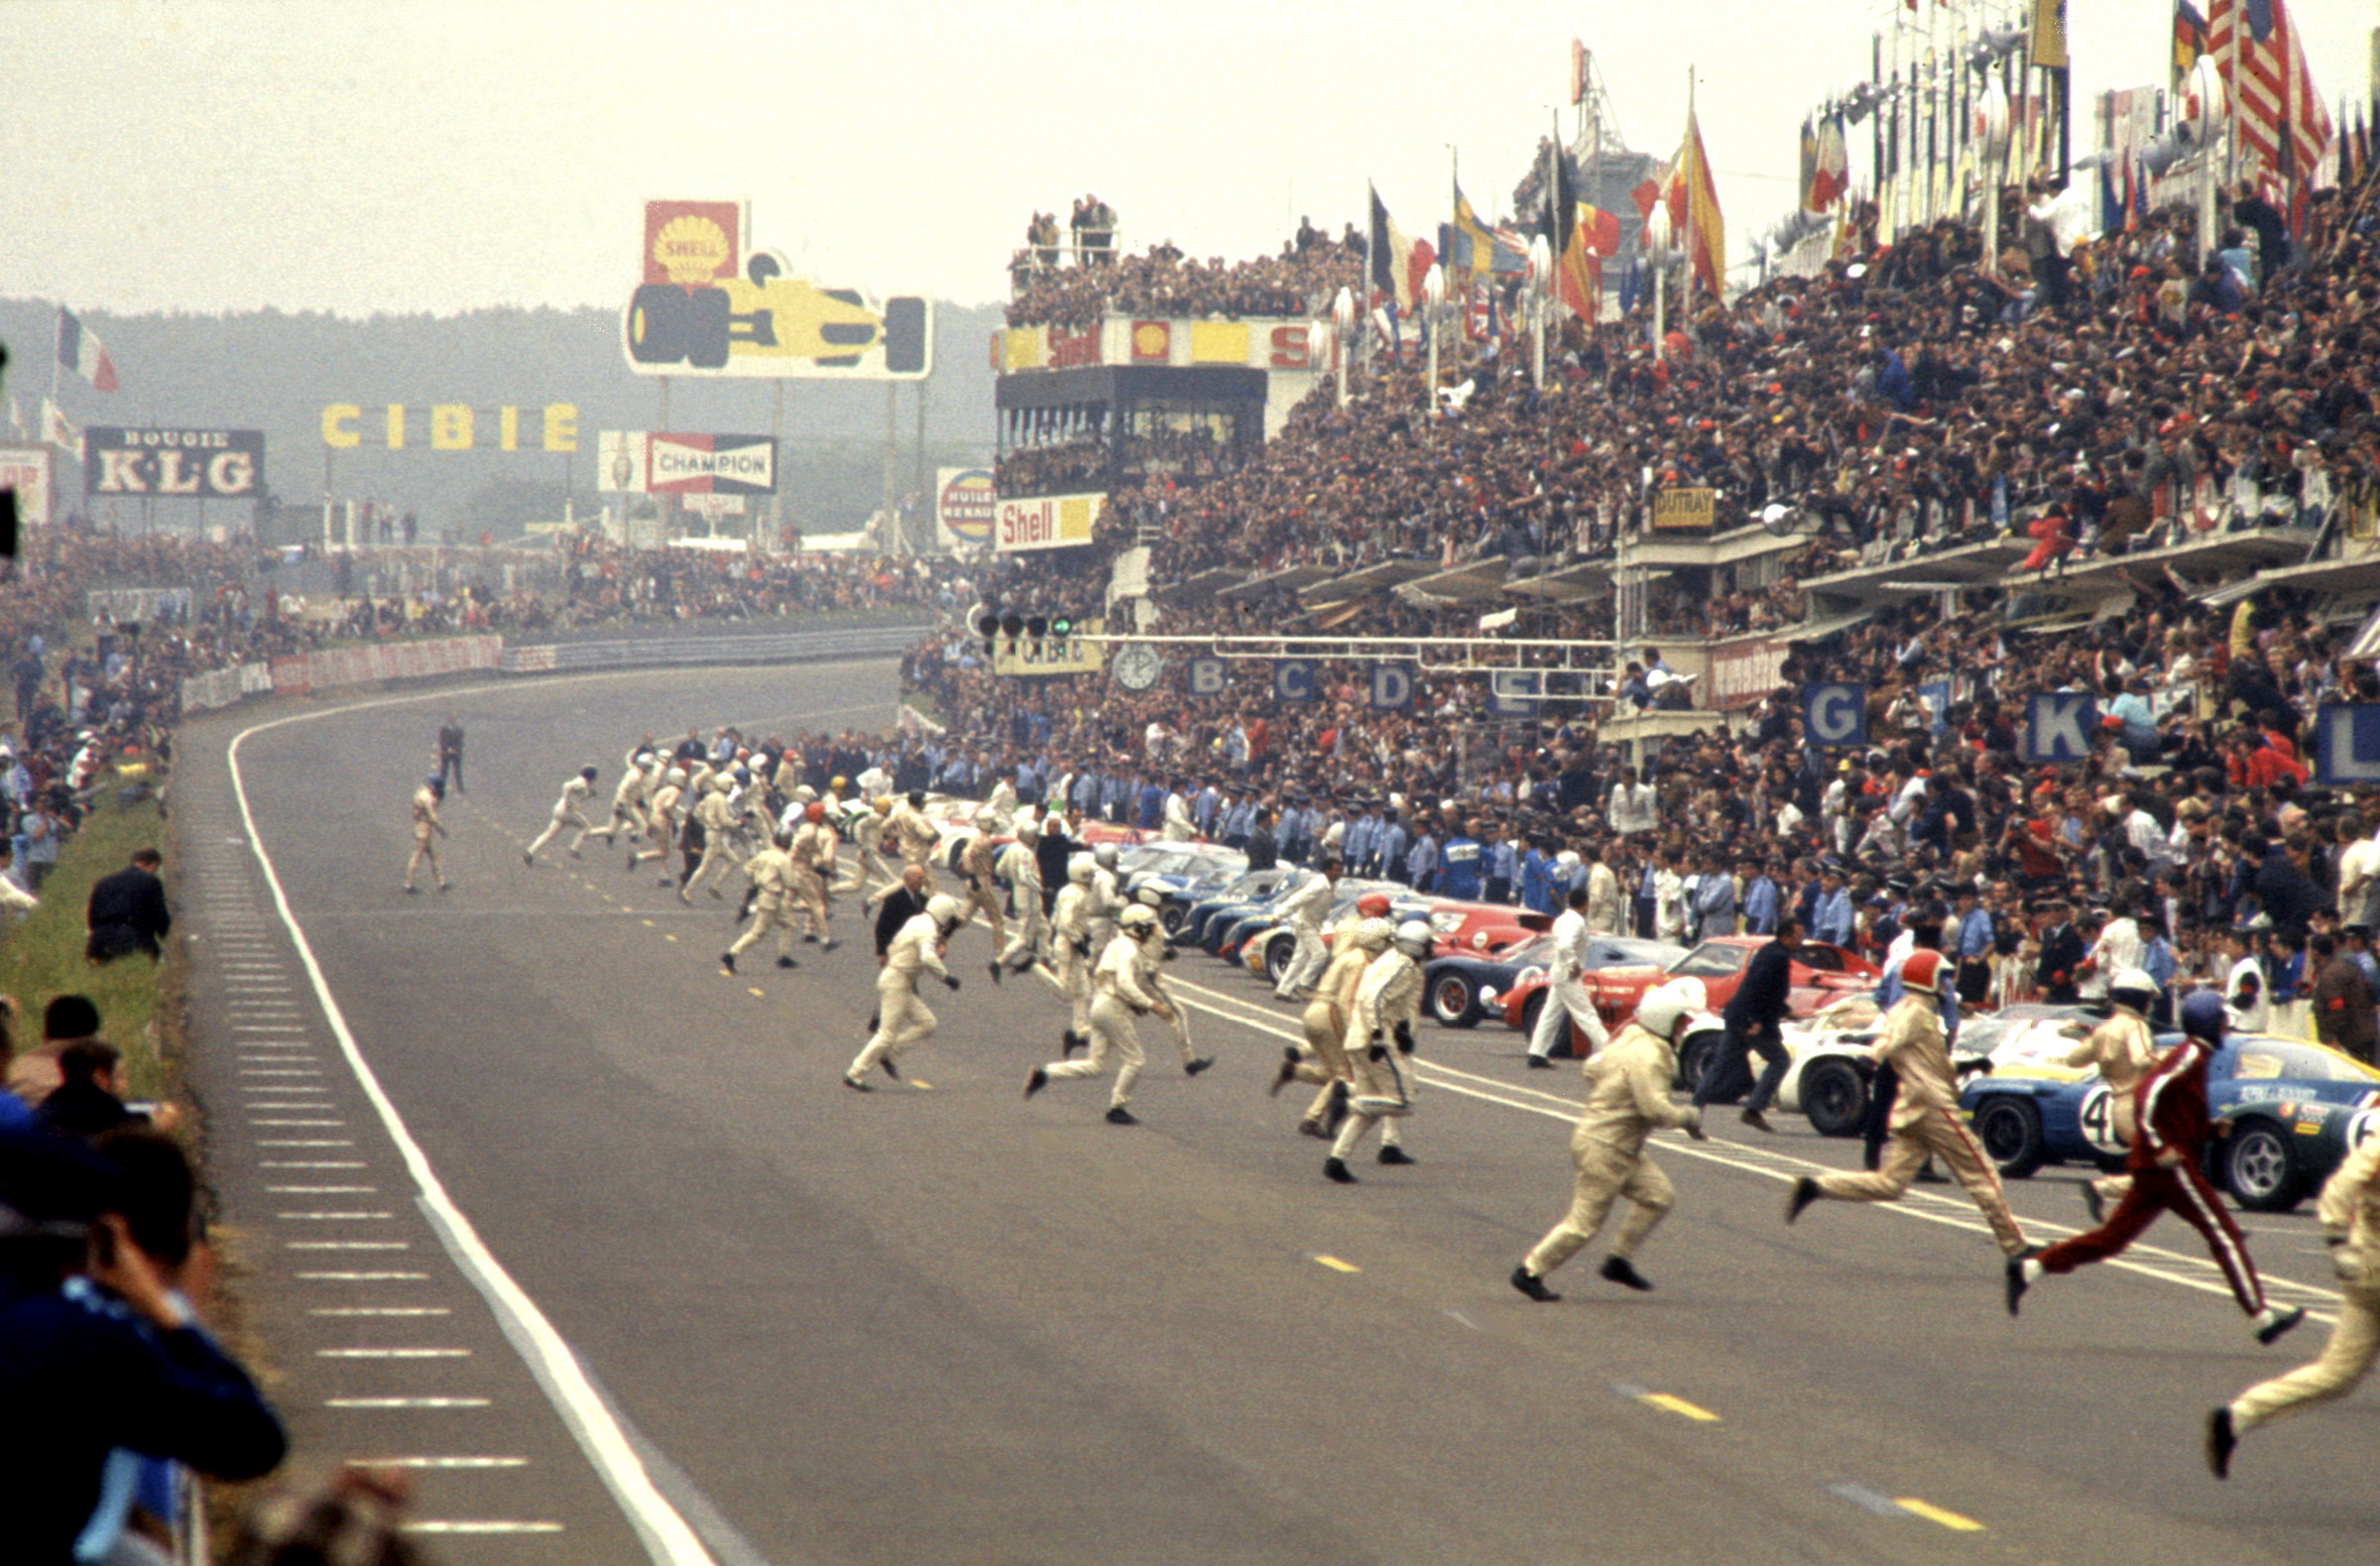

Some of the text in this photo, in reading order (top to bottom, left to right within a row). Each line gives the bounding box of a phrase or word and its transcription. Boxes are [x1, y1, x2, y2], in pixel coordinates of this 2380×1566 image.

[664, 239, 718, 257] SHELL
[125, 430, 229, 446] BOUGIE
[321, 403, 577, 451] CIBIE
[659, 453, 766, 474] CHAMPION
[944, 507, 992, 518] RENAU
[1003, 501, 1052, 543] Shell
[1193, 660, 1224, 692] B
[1277, 661, 1308, 698] C
[1374, 666, 1409, 706] D
[1498, 671, 1531, 711] E
[1811, 685, 1857, 740] G
[2036, 695, 2090, 756] K
[2331, 707, 2380, 779] L
